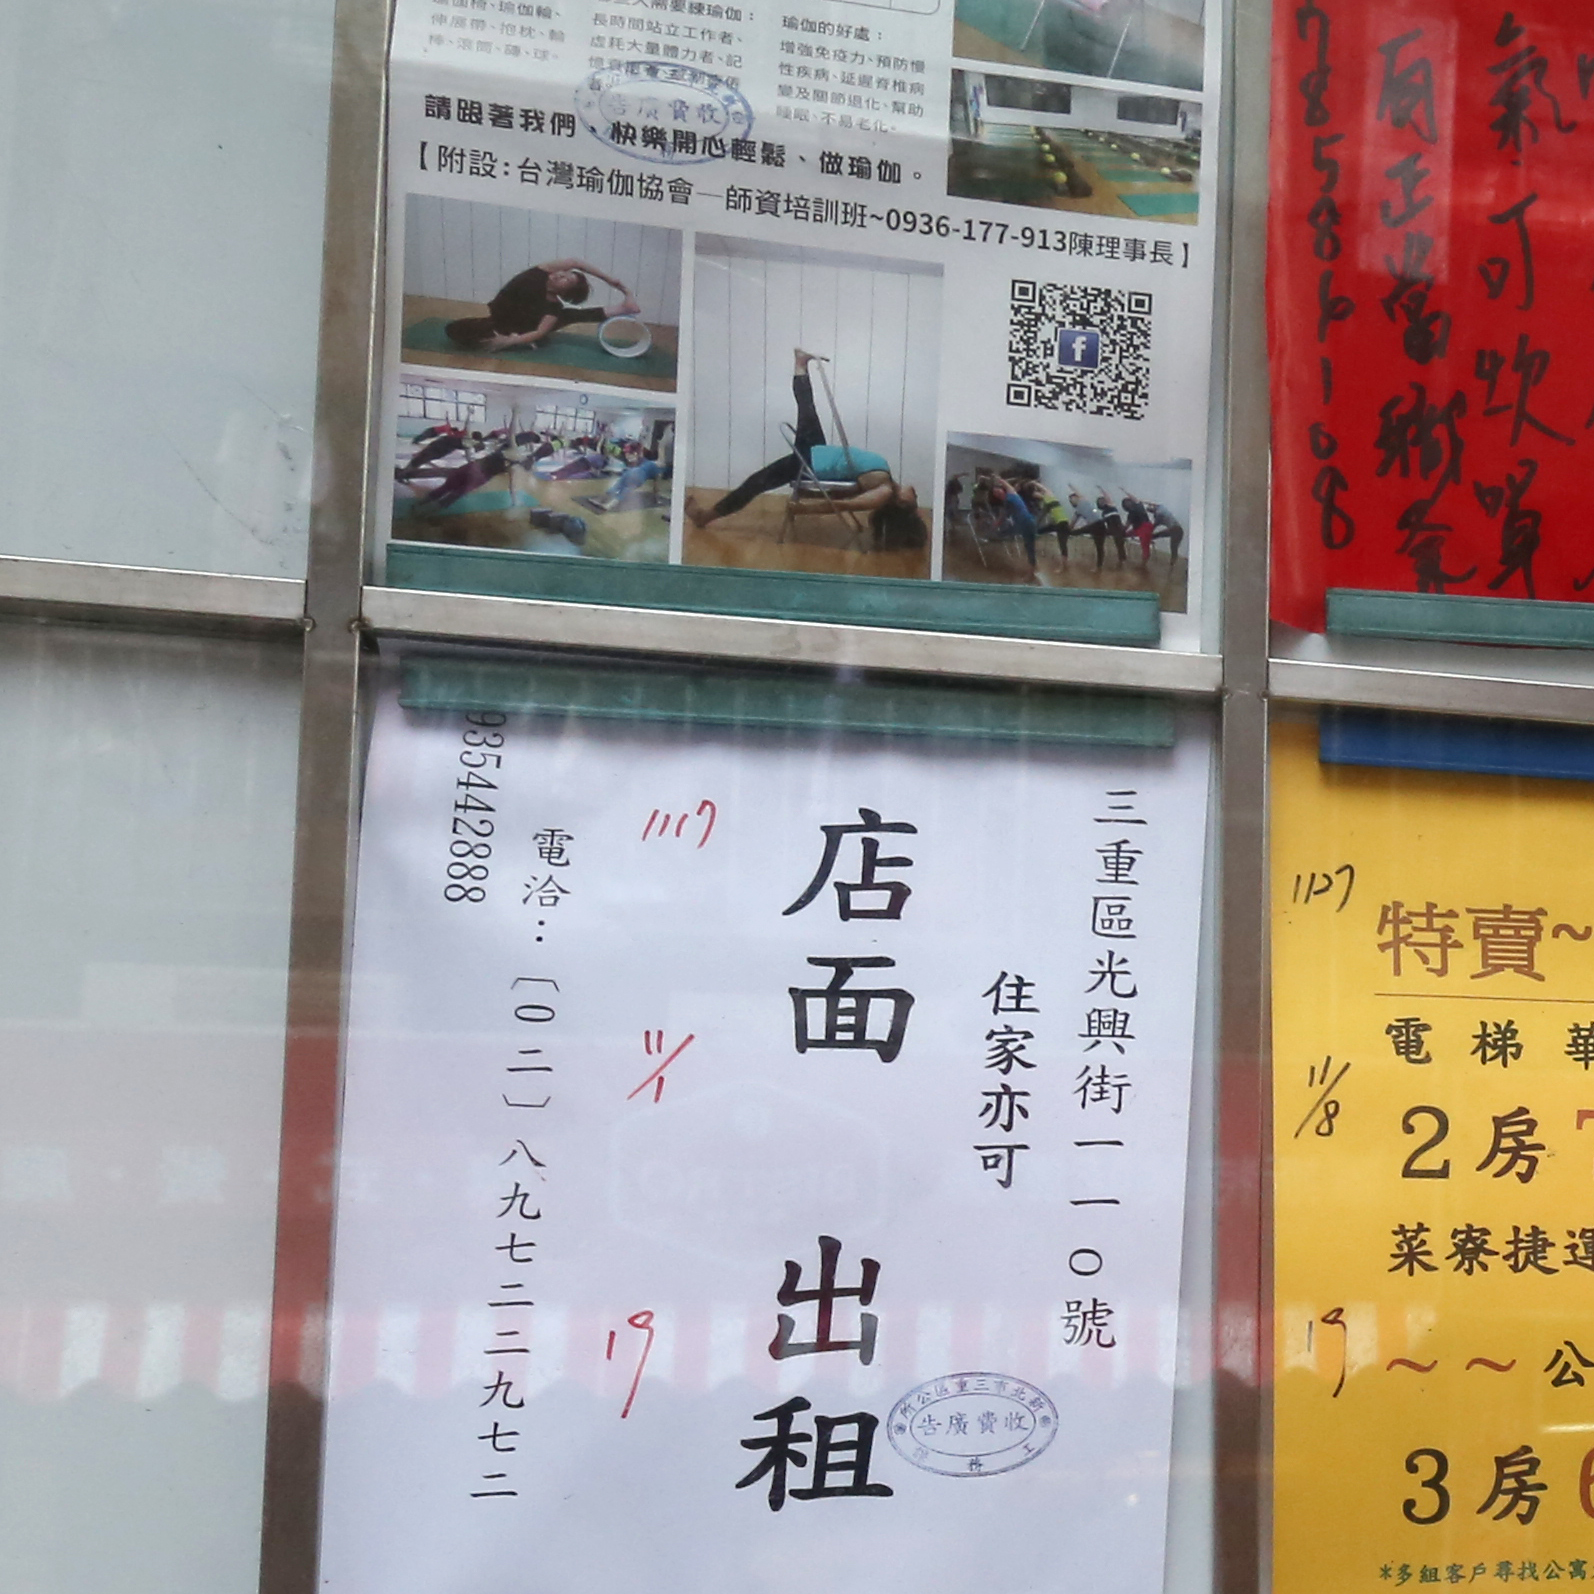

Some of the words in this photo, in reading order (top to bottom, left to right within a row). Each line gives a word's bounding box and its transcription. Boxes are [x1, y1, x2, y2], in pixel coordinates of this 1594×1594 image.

[425, 93, 577, 138] 請跟著我們
[780, 807, 918, 1064] 店面
[974, 969, 1041, 1189] 住家亦可
[735, 1234, 895, 1513] 出租
